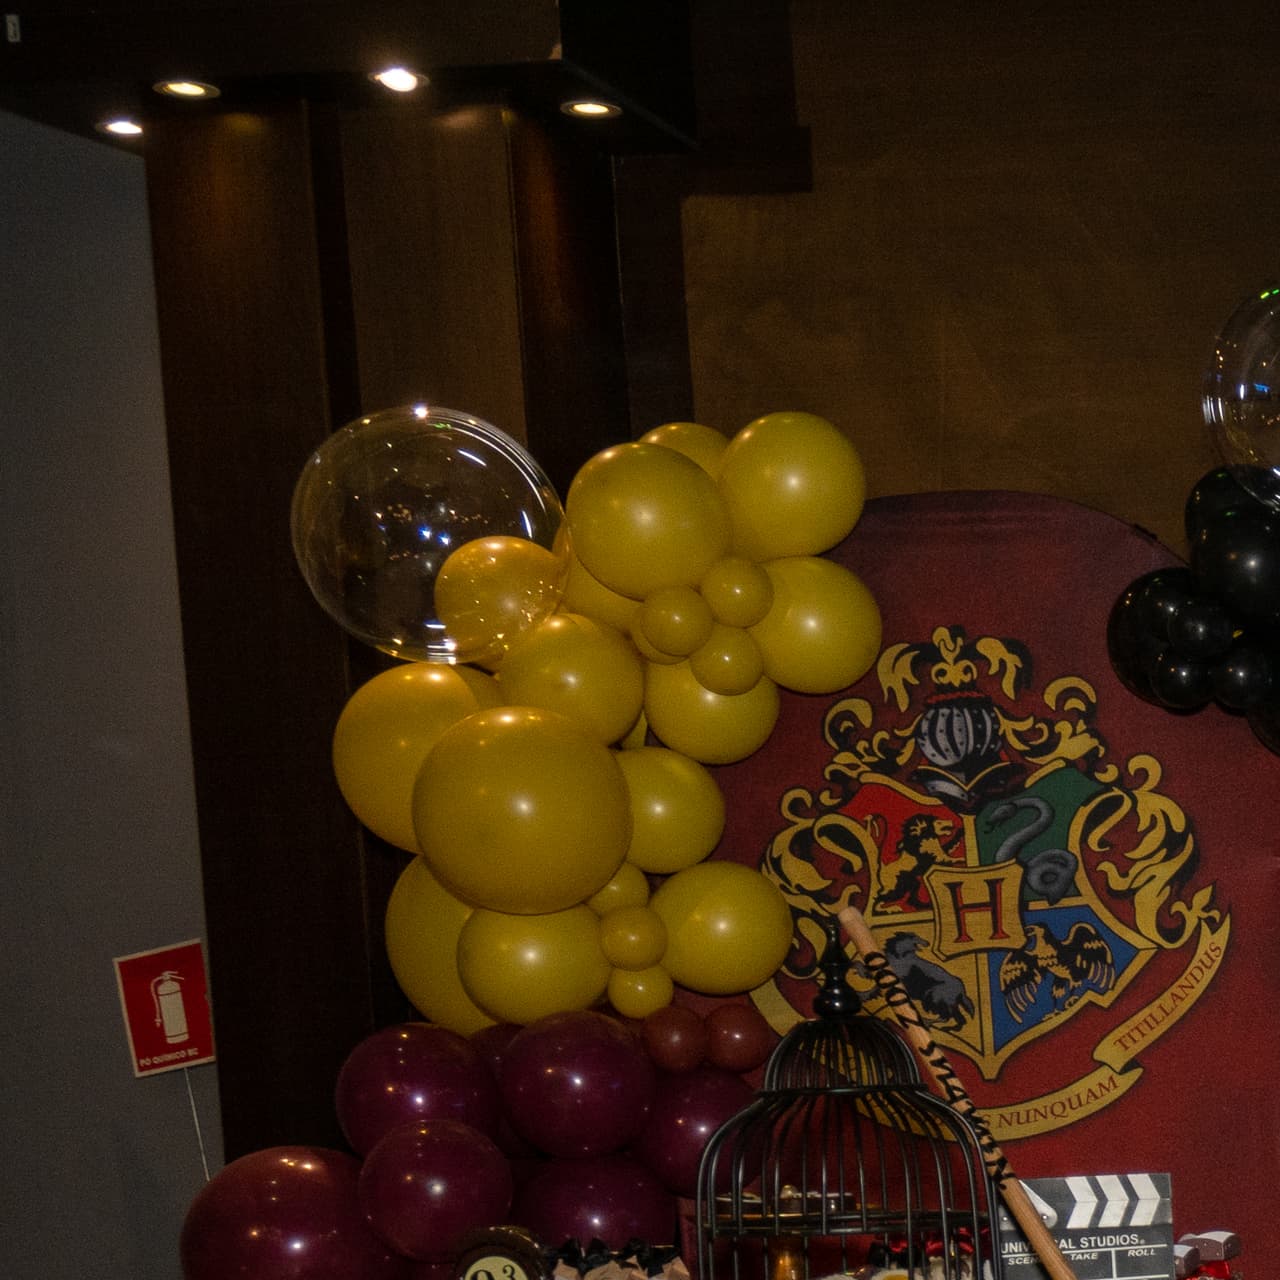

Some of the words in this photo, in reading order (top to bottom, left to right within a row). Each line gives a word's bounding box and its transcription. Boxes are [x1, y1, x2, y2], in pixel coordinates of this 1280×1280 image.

[943, 877, 1010, 943] H
[999, 1074, 1119, 1129] NUNQUAM
[1113, 942, 1223, 1052] TITILLANDUS
[1069, 1252, 1098, 1261] TAKE
[1127, 1248, 1156, 1257] ROLL
